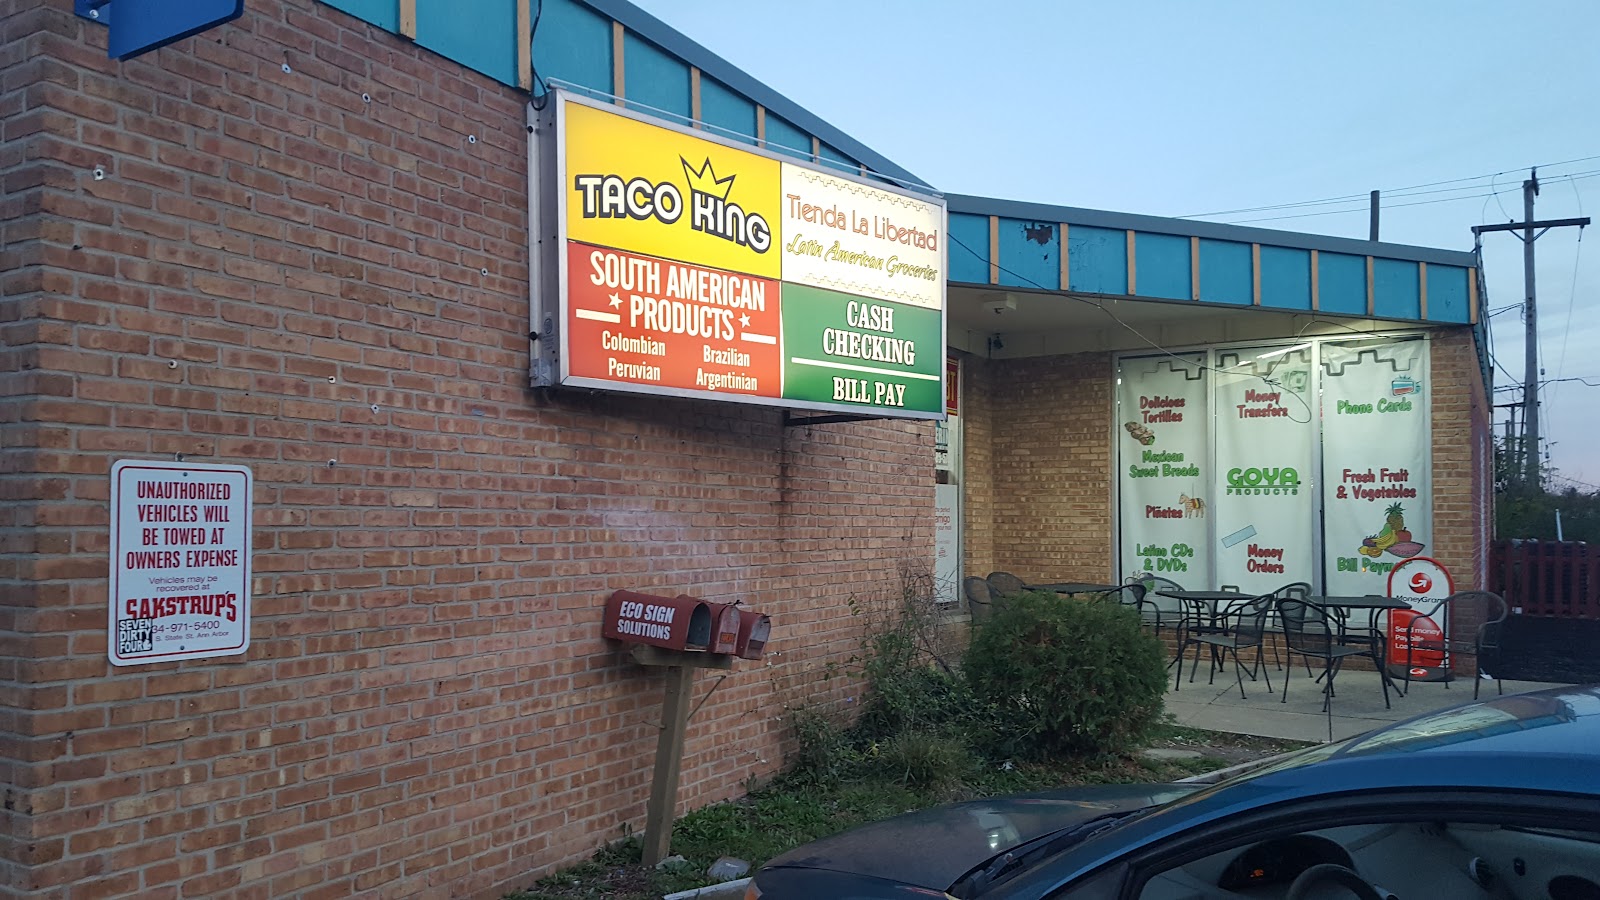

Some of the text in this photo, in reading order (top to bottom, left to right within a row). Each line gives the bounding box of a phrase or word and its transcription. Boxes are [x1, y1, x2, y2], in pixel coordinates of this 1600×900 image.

[575, 174, 771, 254] TACO KING
[787, 194, 937, 251] Tienda La Libertad
[786, 234, 938, 281] Latin American Groceries
[590, 250, 765, 311] SOUTH AMERICAN
[630, 295, 734, 341] PRODUCTS
[846, 301, 894, 332] CASH
[602, 331, 665, 356] Colombian
[823, 327, 915, 366] CHECKING
[703, 345, 750, 367] Brazilian
[608, 358, 660, 380] Peruvian
[696, 368, 757, 391] Argentinian
[833, 377, 906, 406] BILL PAY
[1245, 389, 1280, 404] Money
[1140, 396, 1185, 409] Delicious
[1237, 404, 1288, 418] Transfers
[1337, 397, 1412, 414] Phone Cards
[1141, 410, 1182, 424] Tortillas
[1142, 450, 1184, 463] Mexican
[1129, 464, 1199, 478] Sweet Breads
[1227, 468, 1298, 486] GOYA
[1343, 468, 1408, 483] Fresh Fruit
[137, 481, 230, 500] UNAUTHORIZED
[1337, 484, 1416, 502] & Vegetables
[137, 505, 229, 522] VEHICLES WILL
[143, 528, 224, 545] BE TOWED AT
[1171, 544, 1194, 557] CDs
[1248, 544, 1284, 561] Money
[127, 550, 238, 569] OWNERS EXPENSE
[1143, 558, 1187, 572] & DVDs
[1247, 559, 1284, 573] Orders
[1337, 557, 1358, 572] Bill
[126, 591, 236, 622] SAKSTRUP'S
[1396, 595, 1444, 604] MoneyGra
[620, 601, 675, 623] ECO SIGN
[120, 619, 152, 630] SEVEN
[152, 620, 220, 633] 34-971-5400
[618, 620, 670, 640] SOLUTIONS
[1415, 628, 1440, 636] money
[120, 629, 152, 641] DIRTY
[120, 641, 144, 653] FOUR
